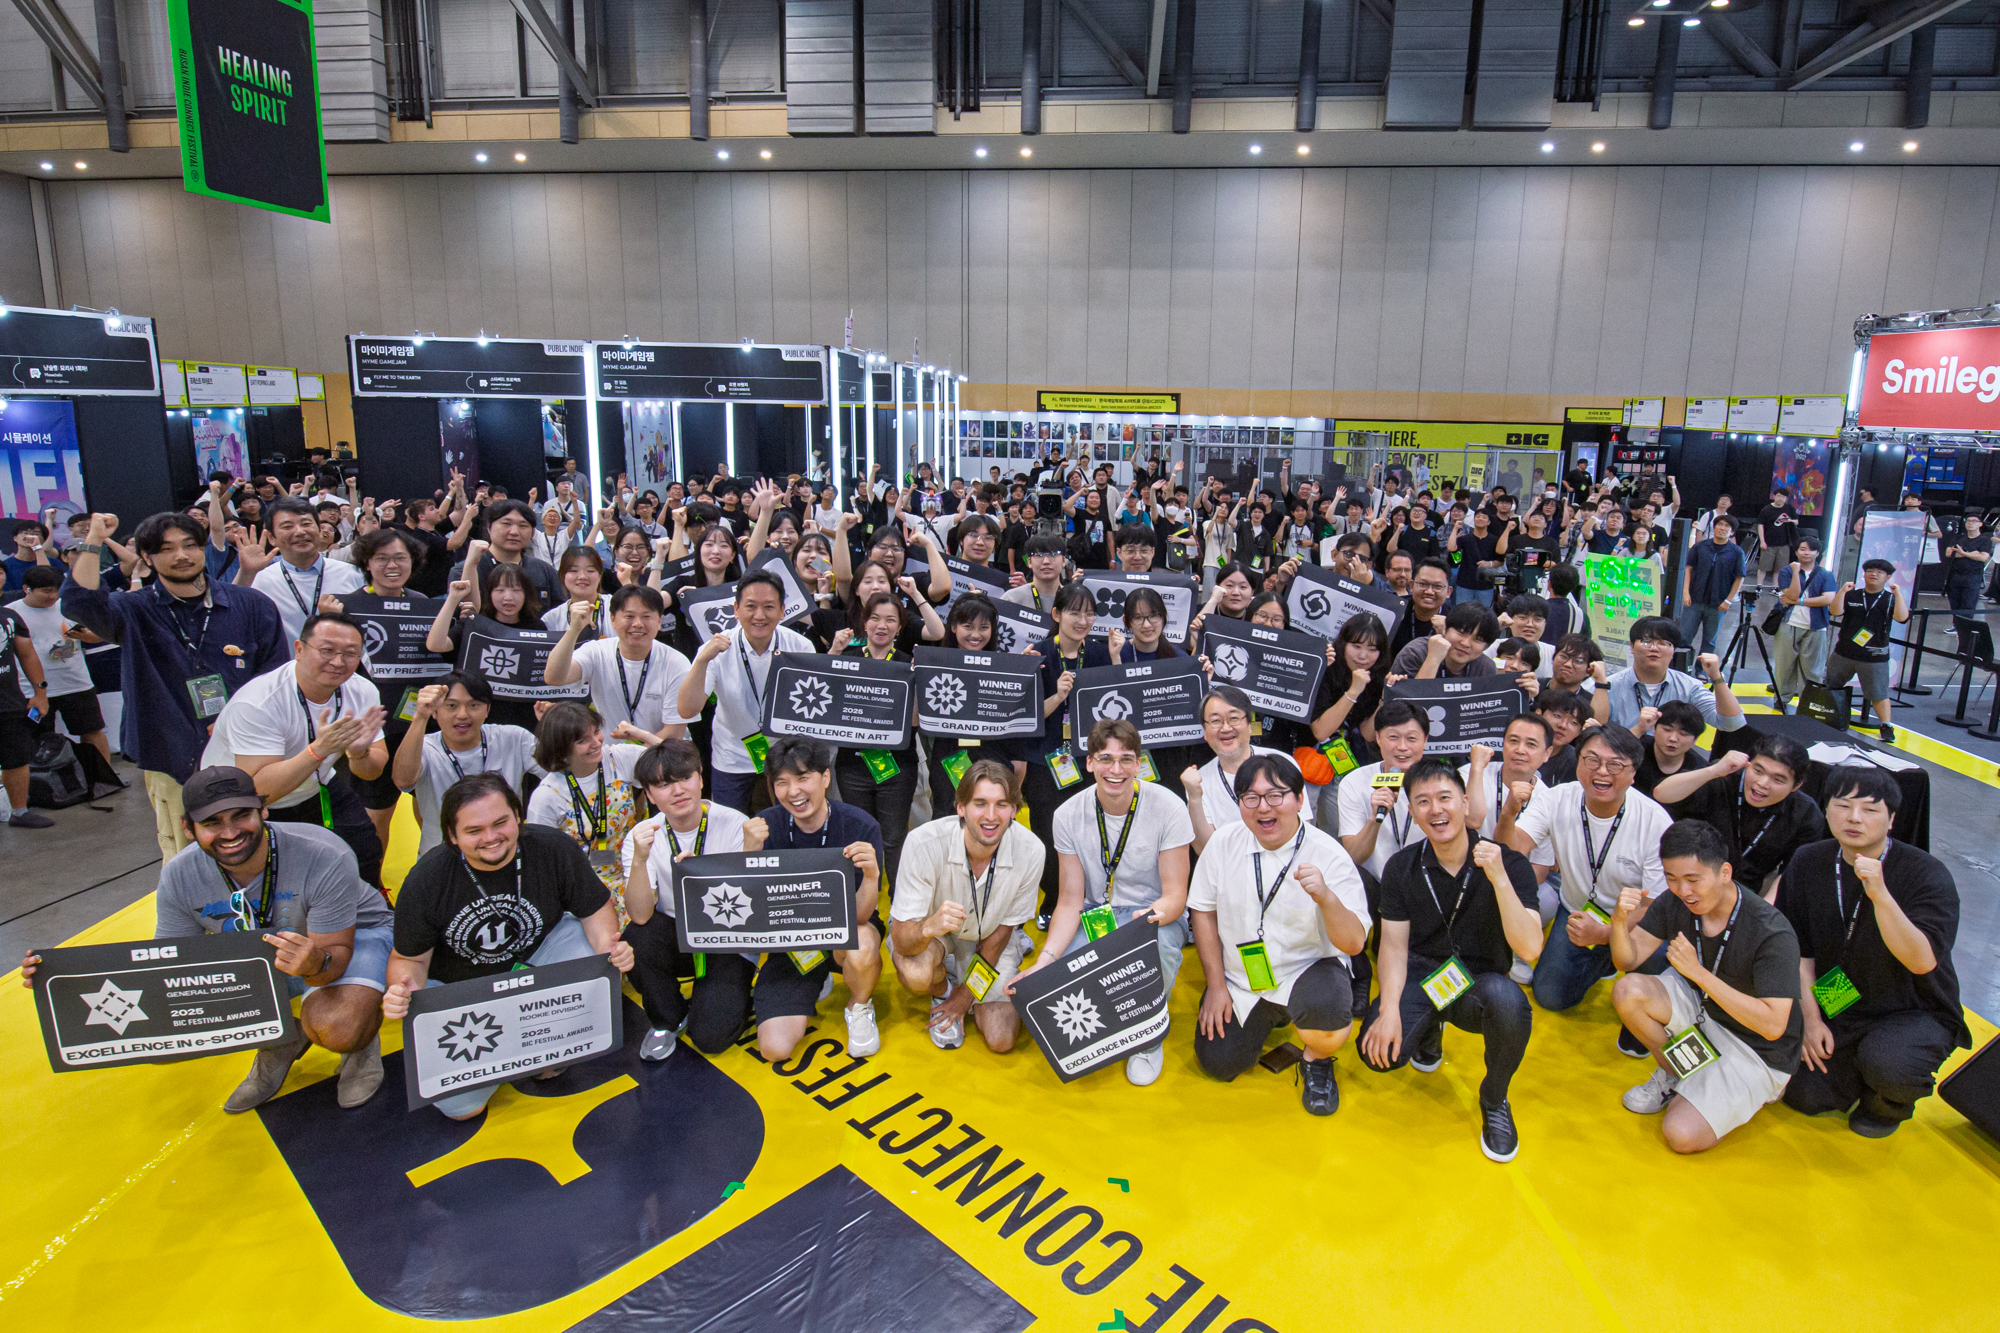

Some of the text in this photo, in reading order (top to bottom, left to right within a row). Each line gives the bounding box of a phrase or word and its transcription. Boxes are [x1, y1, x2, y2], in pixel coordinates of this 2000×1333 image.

[218, 45, 293, 98] HEALING
[178, 48, 198, 168] BUSAN INDIE CONNECT FESTIVAL
[230, 83, 287, 126] SPIRIT
[109, 322, 147, 334] PUBLIC INDIE
[361, 345, 415, 357] 마이미게임잼
[548, 345, 568, 353] PUBLIC
[785, 350, 821, 358] PUBLIC INDIE
[602, 350, 655, 363] 마이미게임잼
[1882, 356, 2000, 403] Smileg
[3, 432, 52, 445] 시뮬레이션
[1506, 433, 1549, 446] BIC
[948, 560, 970, 573] BIC
[1338, 580, 1361, 594] BIC
[384, 601, 411, 611] BIC
[784, 603, 801, 616] DIO
[1019, 610, 1042, 623] BIC
[1028, 632, 1045, 640] WIN
[1252, 628, 1279, 642] BIC
[832, 660, 860, 671] BIC
[964, 655, 992, 666] BIC
[1263, 653, 1304, 668] WINNER
[1126, 666, 1153, 678] BIC
[1261, 661, 1308, 676] GENERAL DIVISION
[979, 679, 1022, 691] WINNER
[1258, 674, 1278, 683] 2025
[845, 684, 890, 696] WINNER
[1143, 685, 1183, 697] WINNER
[1265, 683, 1286, 693] FESTIVAL
[1286, 687, 1304, 697] AWARDS
[1443, 683, 1472, 693] BIC
[1143, 695, 1167, 703] GENERAL
[1263, 698, 1273, 706] IN
[1274, 701, 1302, 713] AUDIO
[1460, 699, 1502, 711] WINNER
[842, 707, 864, 715] 2025
[978, 702, 998, 710] 2025
[850, 716, 873, 724] FESTIVAL
[1152, 716, 1173, 724] FESTIVAL
[784, 724, 853, 739] EXCELLENCE
[941, 722, 980, 732] GRAND
[1143, 729, 1203, 741] SOCIAL IMPACT
[746, 857, 780, 868] BIC
[766, 881, 822, 894] WINNER
[767, 894, 800, 902] GENERAL
[446, 897, 544, 937] ENGINE ENGINE
[768, 909, 795, 917] 2025
[454, 912, 477, 940] ENGINE
[780, 917, 807, 925] FESTIVAL
[807, 916, 832, 924] AWARDS
[462, 918, 481, 941] ENGINE
[693, 932, 843, 944] EXCELLENCE IN ACTION
[131, 946, 178, 962] BIC
[1067, 950, 1099, 973] BIC
[164, 973, 237, 988] WINNER
[1099, 960, 1146, 988] WINNER
[493, 974, 535, 993] BIC
[1106, 967, 1158, 996] GENERAL DIVISION
[166, 984, 251, 999] GENERAL DIVISION
[520, 993, 583, 1013] WINNER
[1115, 998, 1137, 1013] 2025
[171, 1007, 205, 1018] 2025
[173, 1009, 261, 1027] BIC FESTIVAL AWARDS
[519, 1004, 585, 1022] ROOKIE DIVISION
[1120, 1014, 1129, 1022] BIC
[1128, 1003, 1152, 1019] FESTIVAL
[521, 1028, 551, 1039] 2025
[522, 1026, 594, 1048] BIC FESTIVAL AWARDS
[66, 1026, 280, 1062] EXCELLENCE IN e-SPORTS
[1065, 1037, 1129, 1071] EXCELLENCE IN
[440, 1042, 594, 1087] EXCELLENCE IN ART
[846, 1092, 1144, 1296] CONNECT
